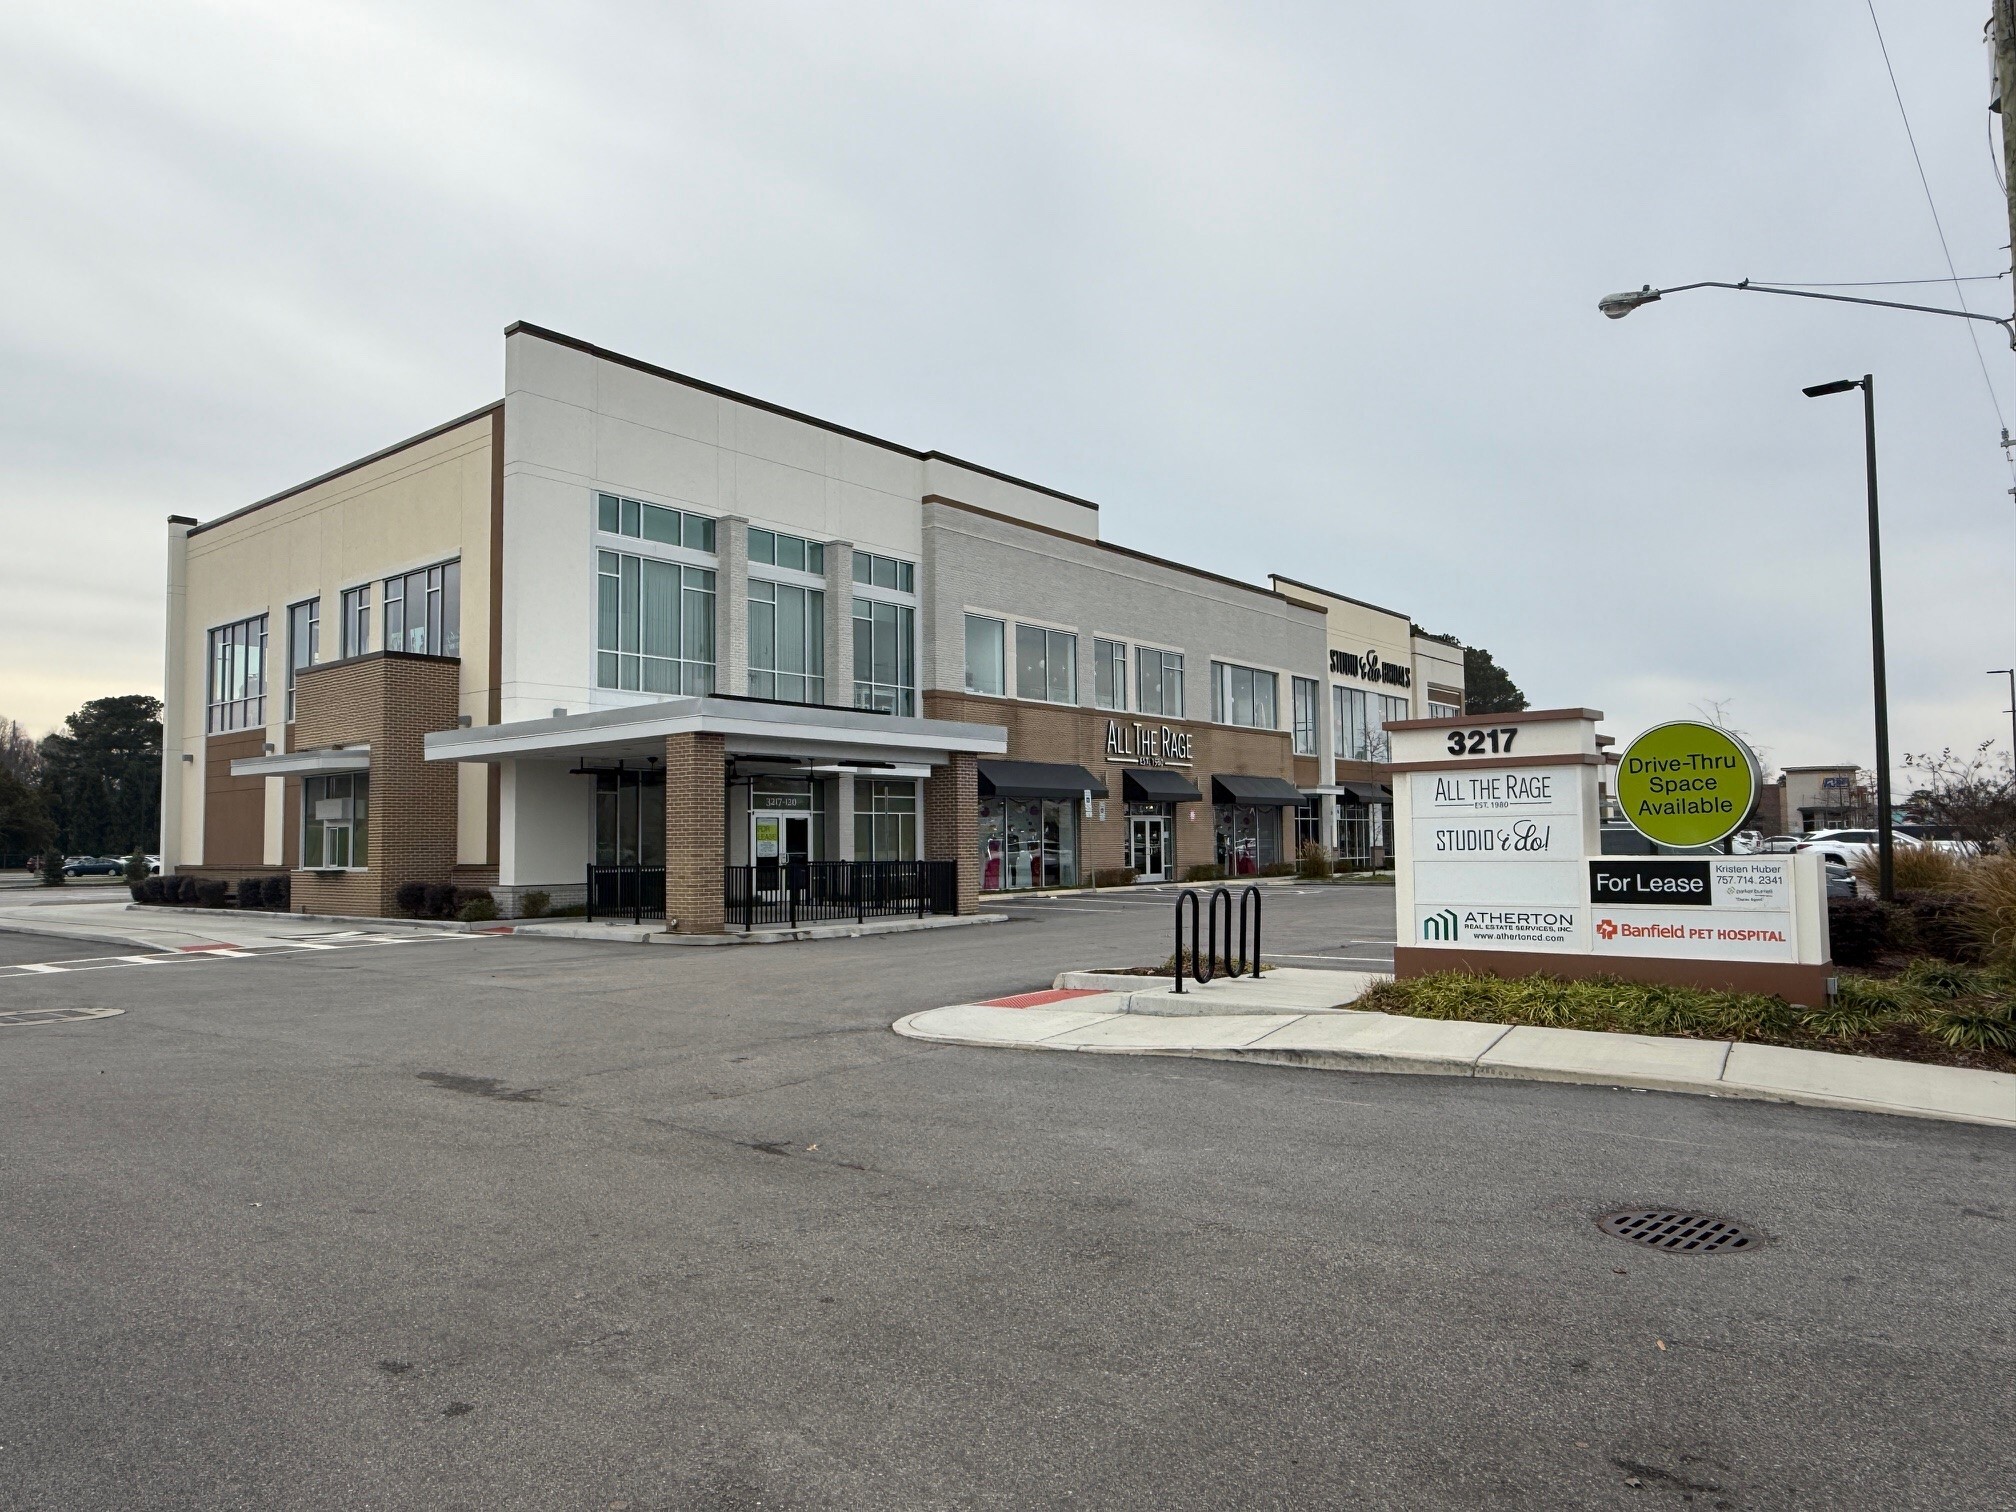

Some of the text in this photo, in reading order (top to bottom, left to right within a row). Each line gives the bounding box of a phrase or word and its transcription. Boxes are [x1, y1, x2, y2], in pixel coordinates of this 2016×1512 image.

[1106, 719, 1193, 759] ALL THE RAGE
[1447, 728, 1518, 756] 3217
[1629, 753, 1736, 774] Drive-Thru
[1435, 774, 1552, 801] ALL THE RAGE
[1649, 776, 1718, 796] Space
[766, 798, 797, 806] 3217-120
[1491, 801, 1509, 809] 1980
[1638, 796, 1733, 816] Available
[1436, 829, 1494, 851] STUDIO
[1513, 819, 1550, 852] do!
[1715, 865, 1781, 873] Kristen Huber
[1597, 873, 1704, 893] For Lease
[1716, 875, 1783, 885] 757.714.2341
[1464, 911, 1574, 925] ATHERTON
[1473, 932, 1565, 942] www.athertoncd.com
[1621, 923, 1786, 942] Banfield PET HOSPITAL
